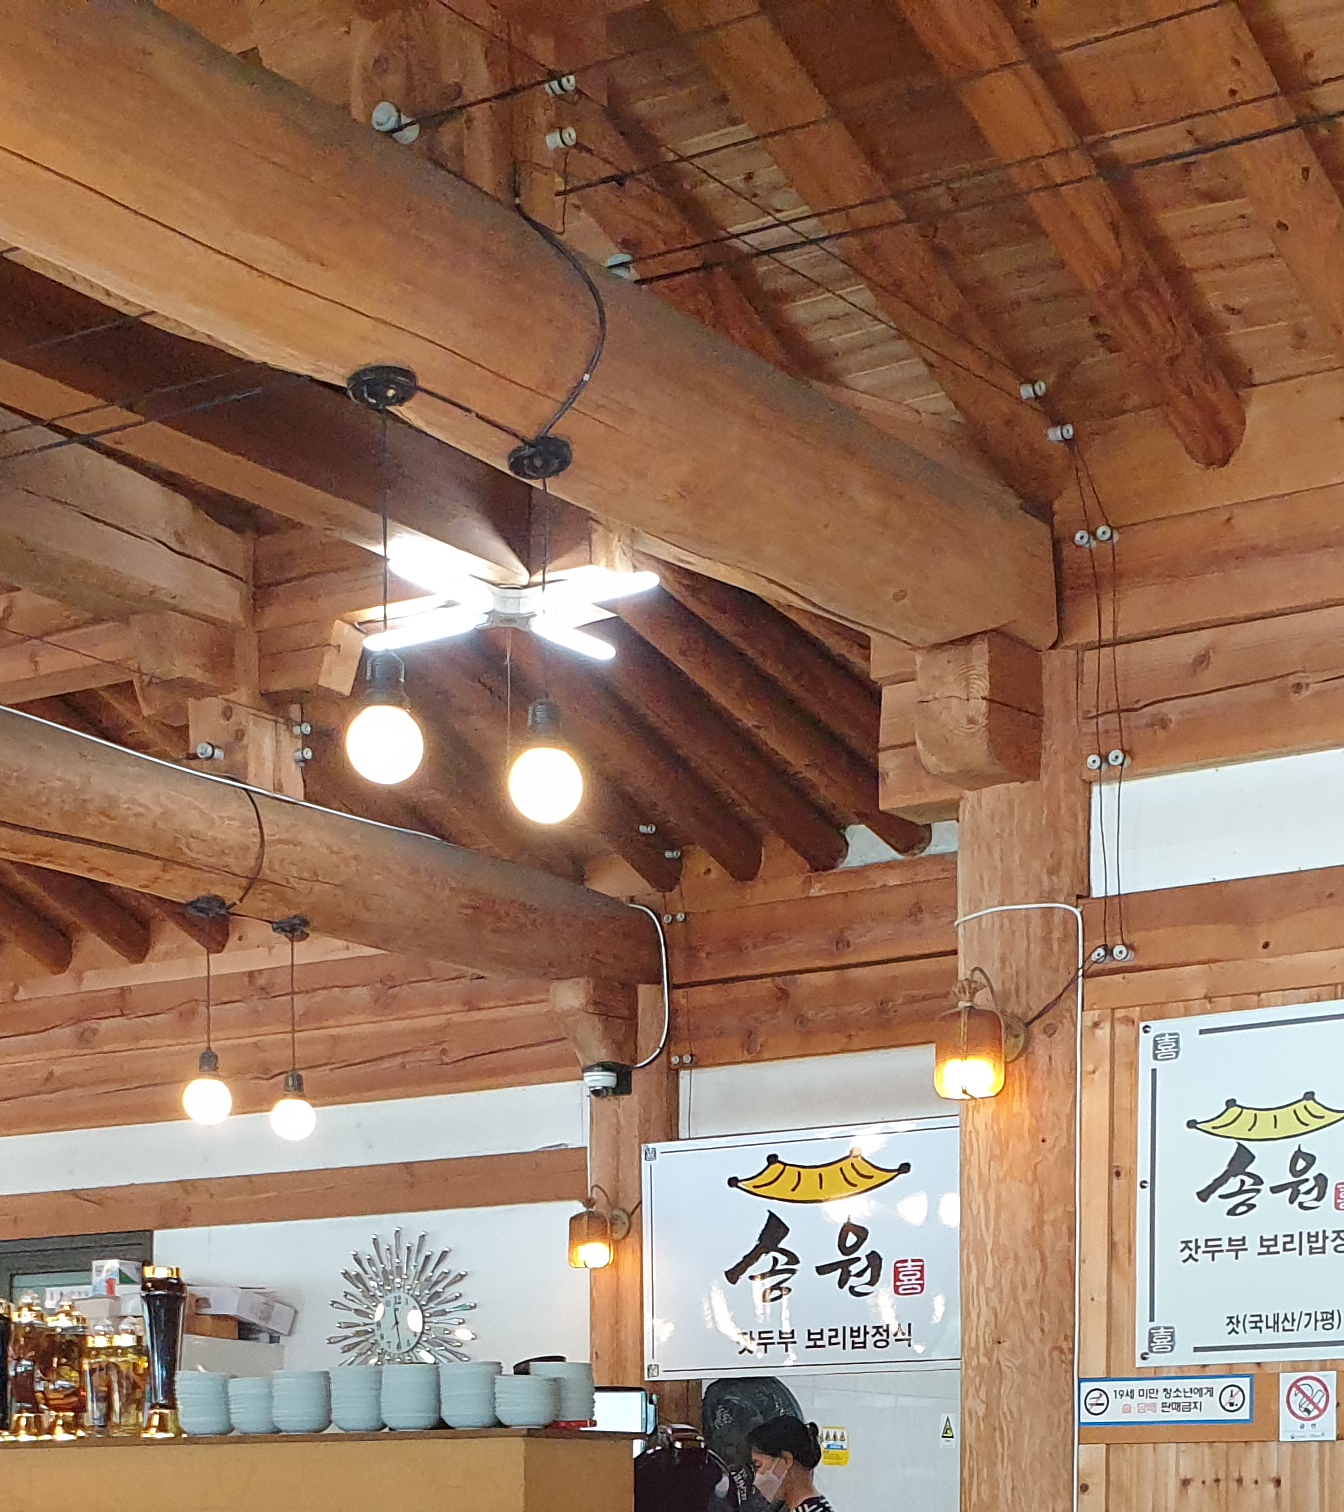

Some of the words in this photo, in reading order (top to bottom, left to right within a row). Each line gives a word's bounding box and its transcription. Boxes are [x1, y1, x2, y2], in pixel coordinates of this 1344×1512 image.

[1178, 1232, 1249, 1264] 잣두부
[805, 1322, 913, 1351] 보리밥정식
[1112, 1388, 1135, 1400] 19세
[1138, 1387, 1159, 1400] 미만
[1160, 1401, 1203, 1413] 판매금지
